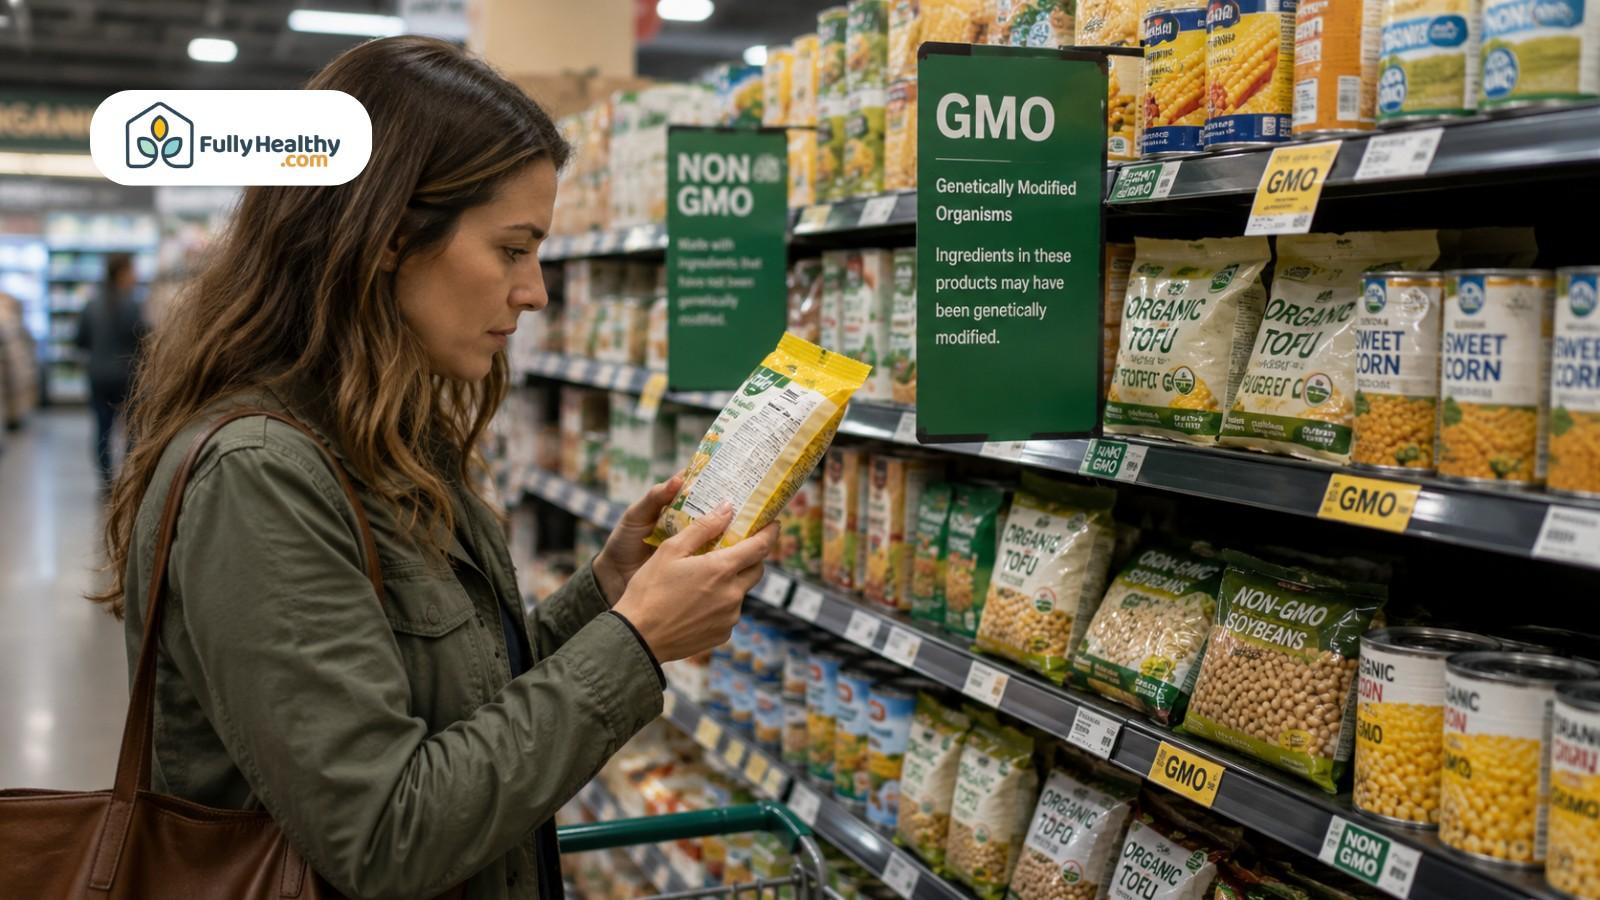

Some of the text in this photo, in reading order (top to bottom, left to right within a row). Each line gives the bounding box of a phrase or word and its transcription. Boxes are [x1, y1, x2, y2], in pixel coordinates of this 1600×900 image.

[936, 92, 1056, 142] GMO
[677, 153, 750, 184] NON
[1266, 167, 1318, 195] GMO
[677, 186, 754, 217] GMO
[935, 177, 1077, 198] Genetically Modified
[935, 205, 1013, 225] Organisms
[935, 246, 1072, 267] Ingredients in these
[935, 275, 1065, 294] products may have
[935, 301, 1047, 321] been genetically
[1125, 296, 1207, 322] ORGANIC
[1264, 299, 1357, 327] ORGANIC
[935, 328, 1001, 346] modified.
[1128, 326, 1179, 354] TOFU
[1260, 328, 1324, 359] TOFU
[1338, 485, 1398, 518] GMO
[1004, 549, 1039, 576] TOFU
[1231, 585, 1329, 628] NON-GMO
[1225, 611, 1309, 651] SOYBEANS
[1164, 754, 1208, 792] GMO
[1040, 789, 1099, 830] ORGANIC
[1343, 828, 1384, 859] NON
[1123, 841, 1182, 887] ORGANIC
[1338, 848, 1380, 878] GMO
[1118, 864, 1160, 900] TOFU
